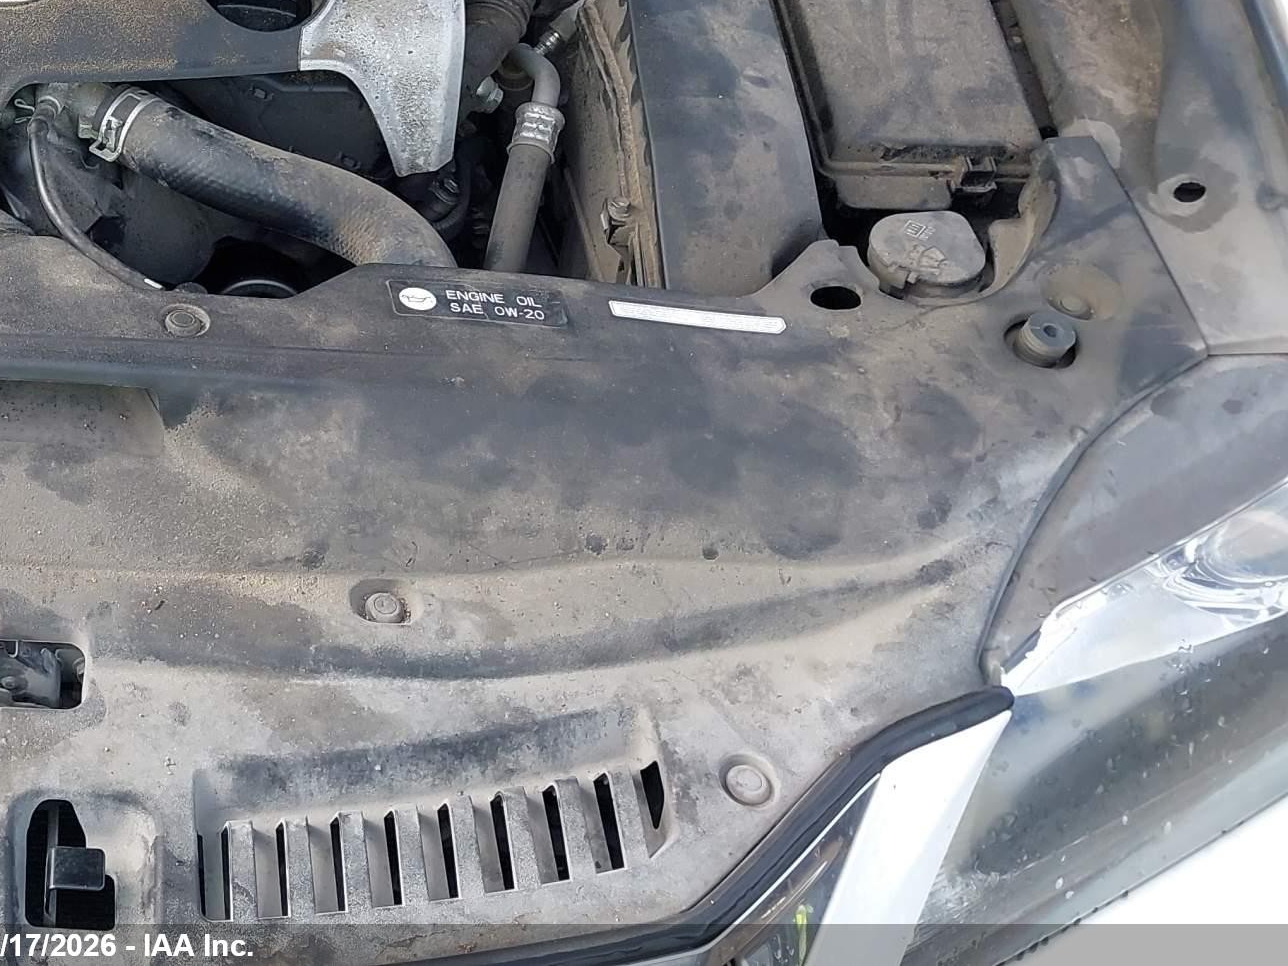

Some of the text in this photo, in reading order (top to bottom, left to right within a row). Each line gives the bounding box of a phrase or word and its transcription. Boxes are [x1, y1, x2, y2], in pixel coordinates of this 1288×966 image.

[445, 290, 542, 308] ENGINE OIL
[449, 302, 545, 320] SAE 0W-20
